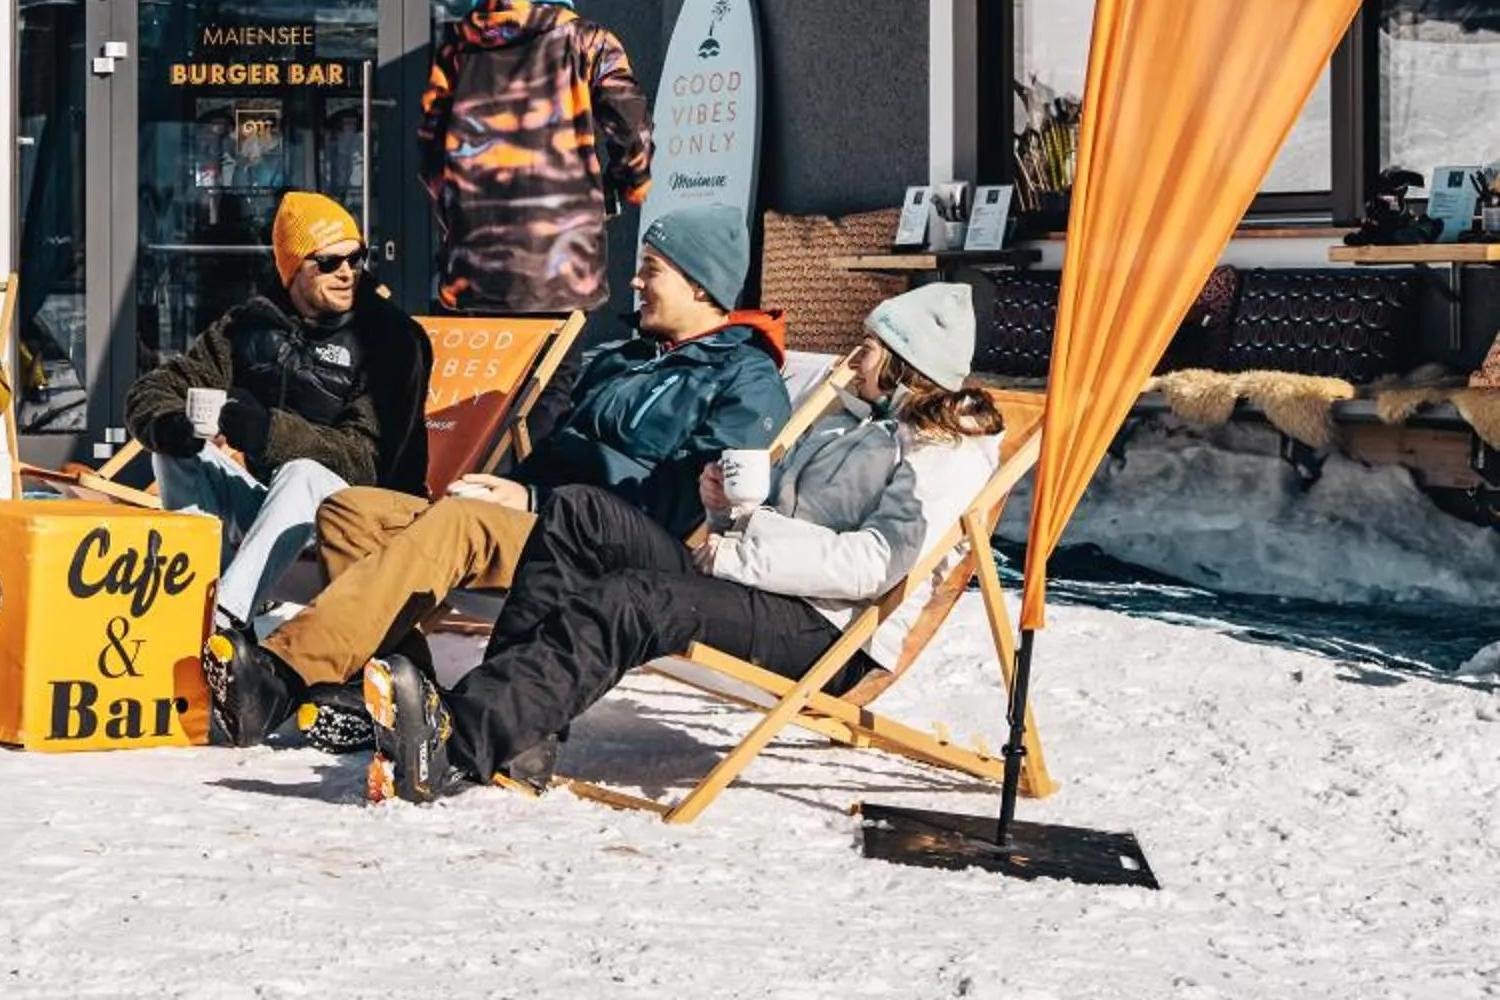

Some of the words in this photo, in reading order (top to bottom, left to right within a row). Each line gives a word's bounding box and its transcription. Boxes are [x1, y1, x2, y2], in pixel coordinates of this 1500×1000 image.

[203, 26, 314, 46] MAIENSEE
[170, 63, 280, 86] BURGER
[289, 63, 344, 87] BAR
[672, 70, 742, 97] GOOD
[671, 100, 737, 127] VIBES
[667, 130, 736, 156] ONLY
[67, 526, 196, 619] Cafe
[97, 615, 148, 680] &
[44, 678, 189, 741] Bar
